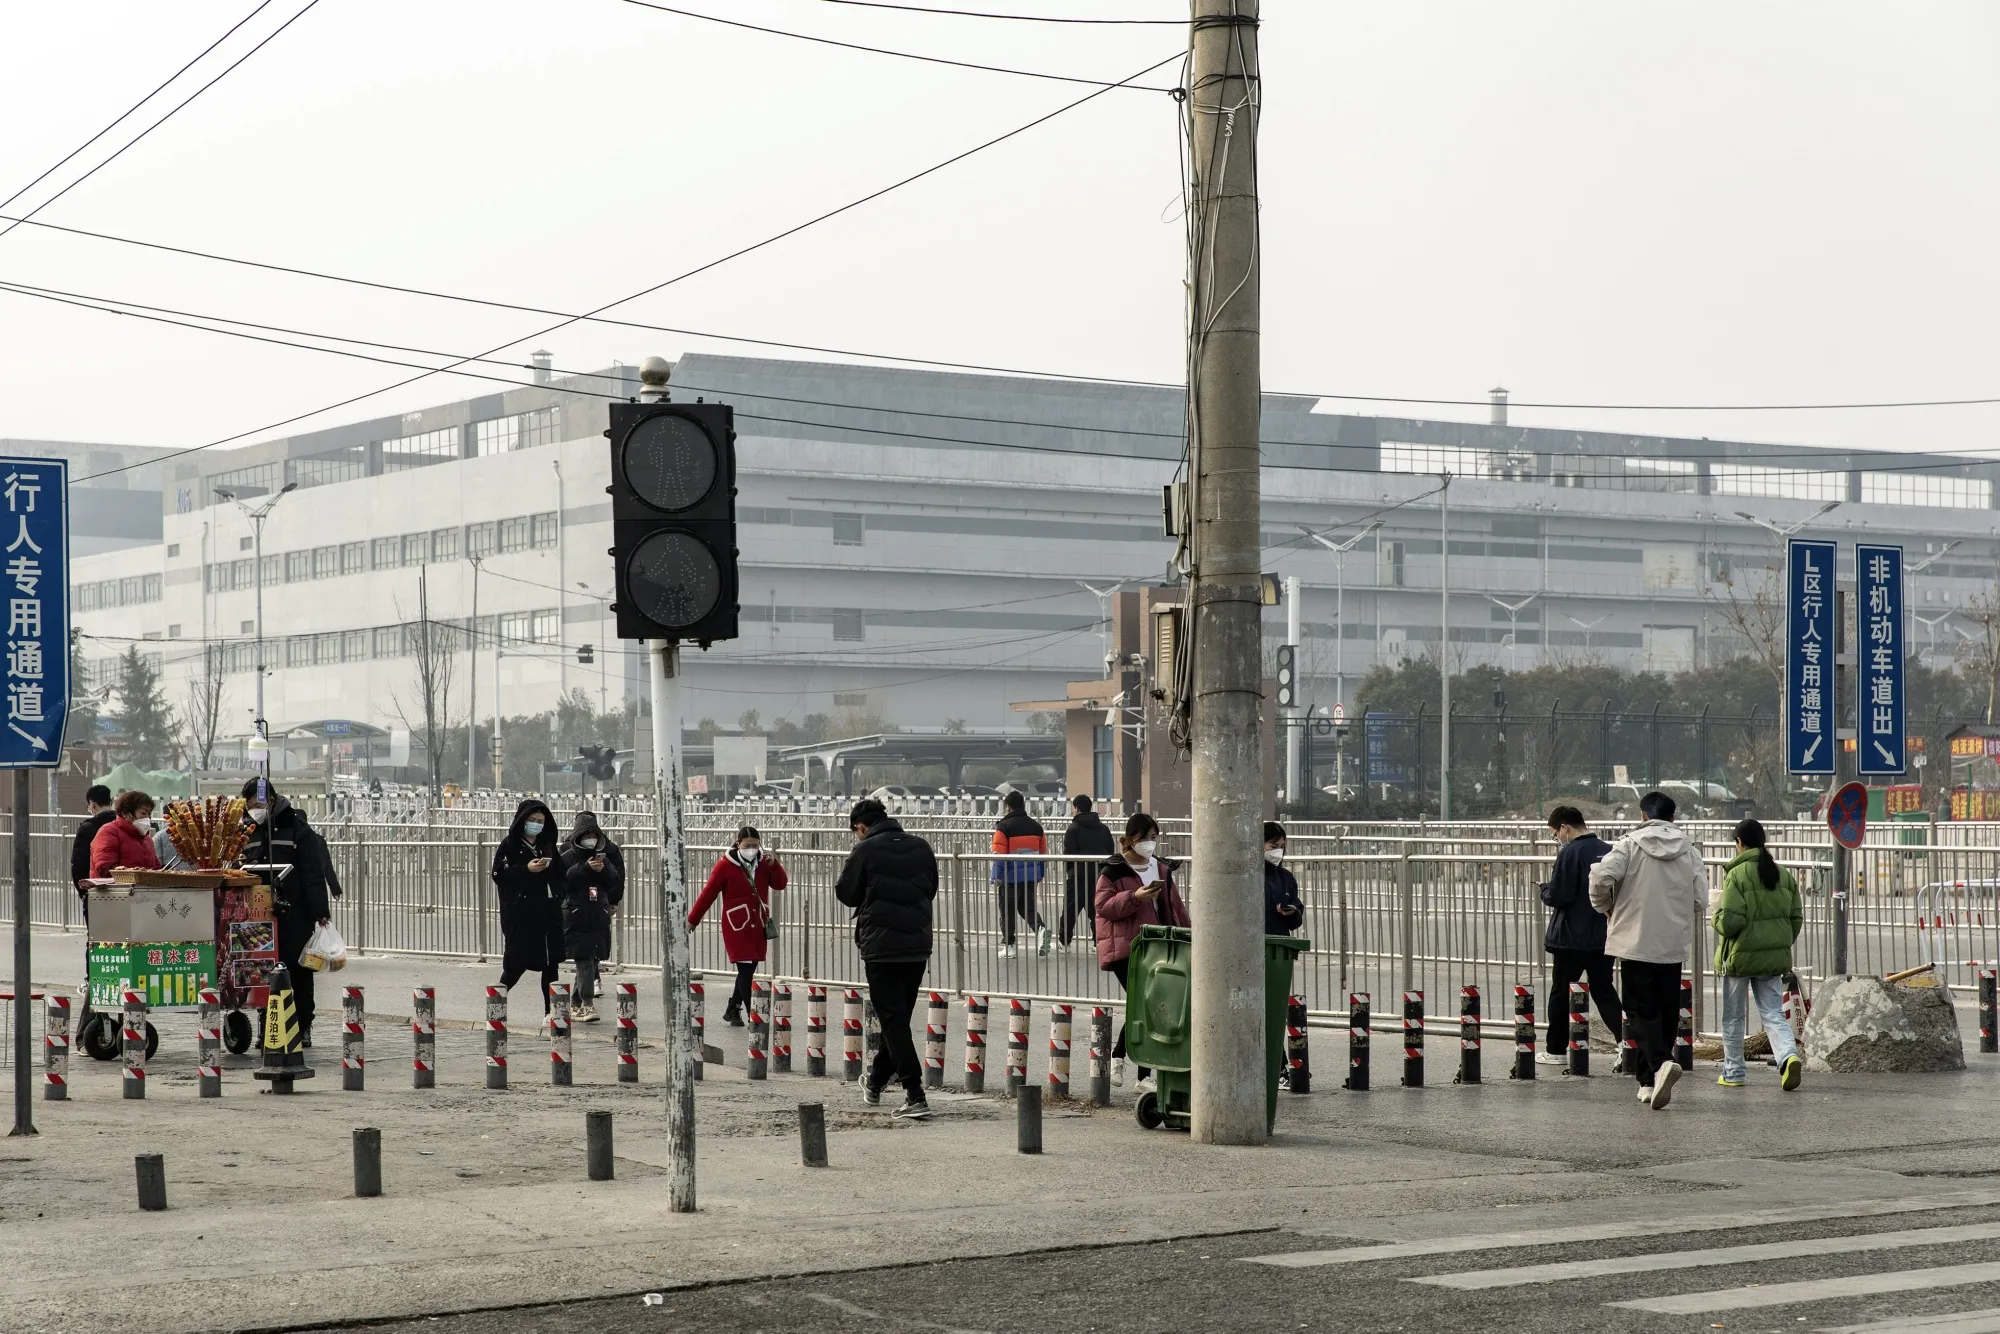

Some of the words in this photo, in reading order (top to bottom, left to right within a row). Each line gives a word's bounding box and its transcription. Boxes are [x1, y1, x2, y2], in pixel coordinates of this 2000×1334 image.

[4, 472, 44, 722] 行人专用通道
[1800, 549, 1823, 734] L区行人专用通道
[1869, 555, 1893, 735] 非机动车道出
[1951, 740, 1983, 755] 鸡蛋灌饼
[1887, 790, 1920, 812] 红薯玉米
[147, 948, 200, 965] 糯米糕
[269, 999, 279, 1046] 请勿泊车
